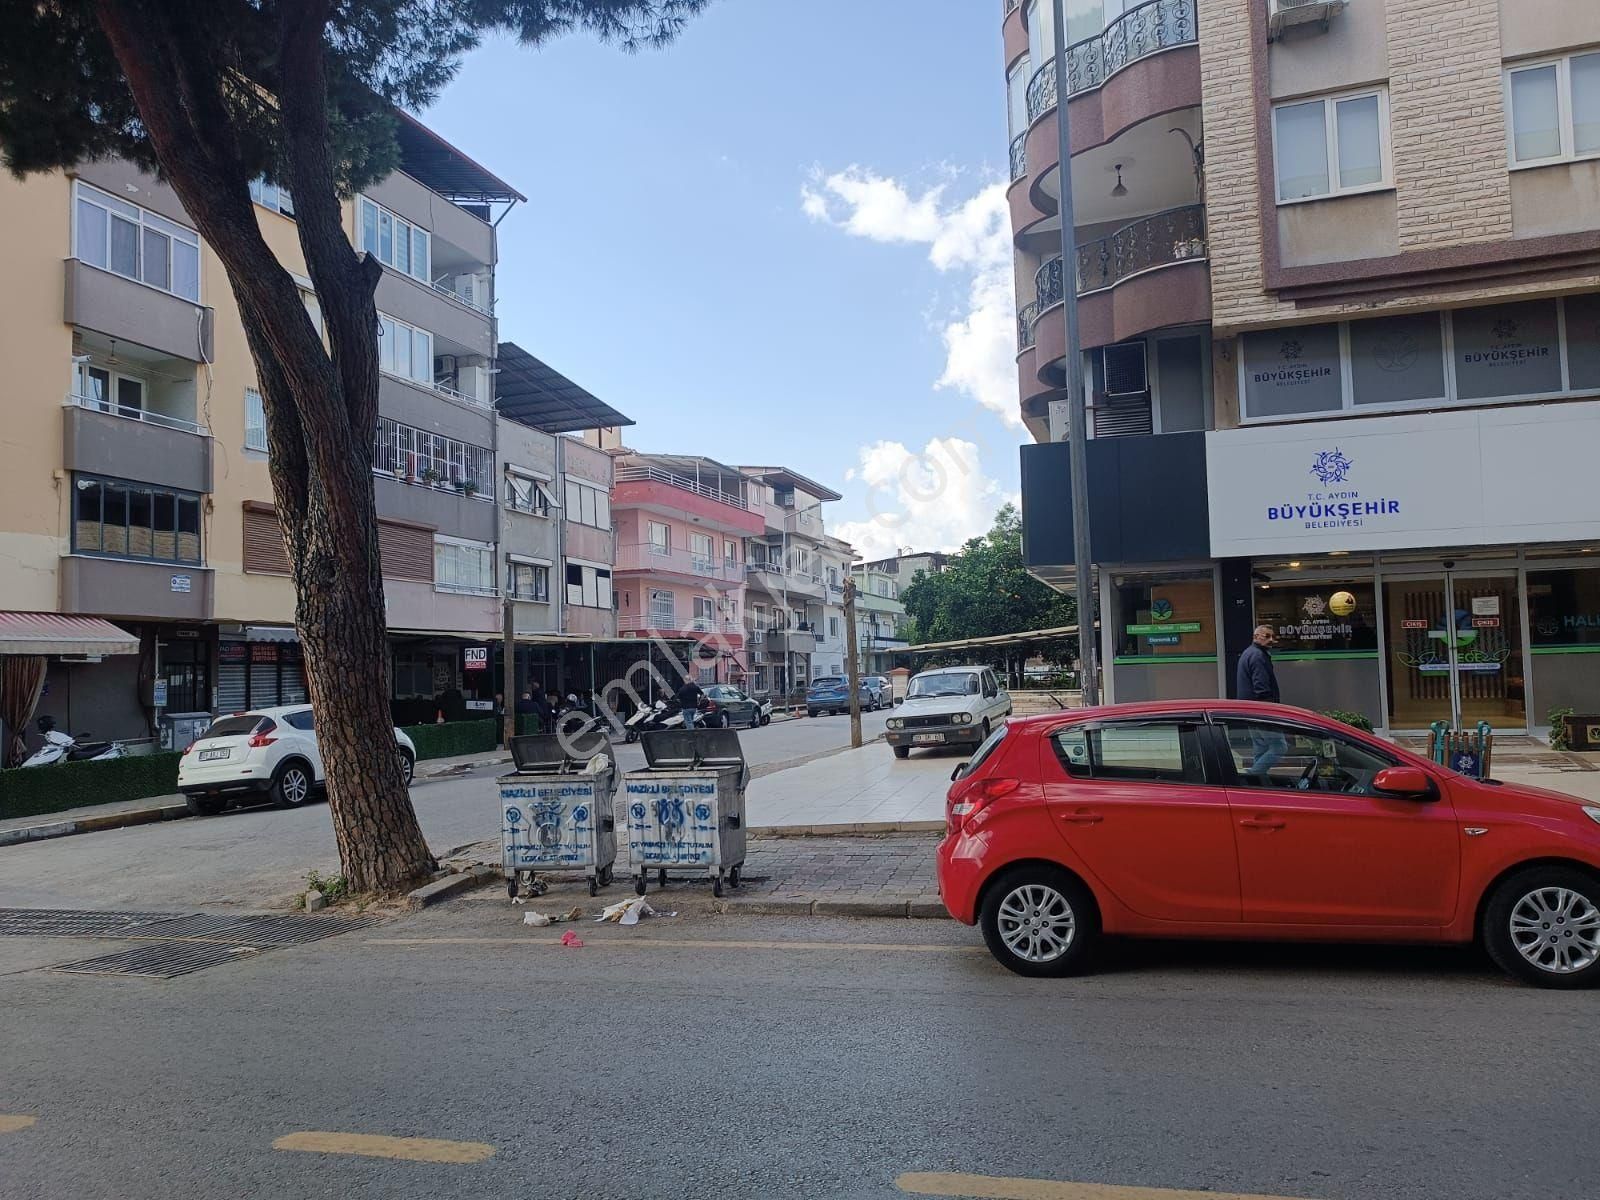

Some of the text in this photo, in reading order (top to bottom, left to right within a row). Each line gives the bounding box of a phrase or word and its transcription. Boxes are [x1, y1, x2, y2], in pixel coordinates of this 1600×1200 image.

[1464, 347, 1549, 363] BÜYÜKŞEHİR
[1254, 366, 1332, 383] BÜYÜKŞEHİR
[1308, 491, 1358, 501] T.C. AYDIN
[1267, 498, 1400, 520] BÜYÜKŞEHİR
[1305, 519, 1363, 529] BELEDİYESİ
[465, 649, 486, 660] FND
